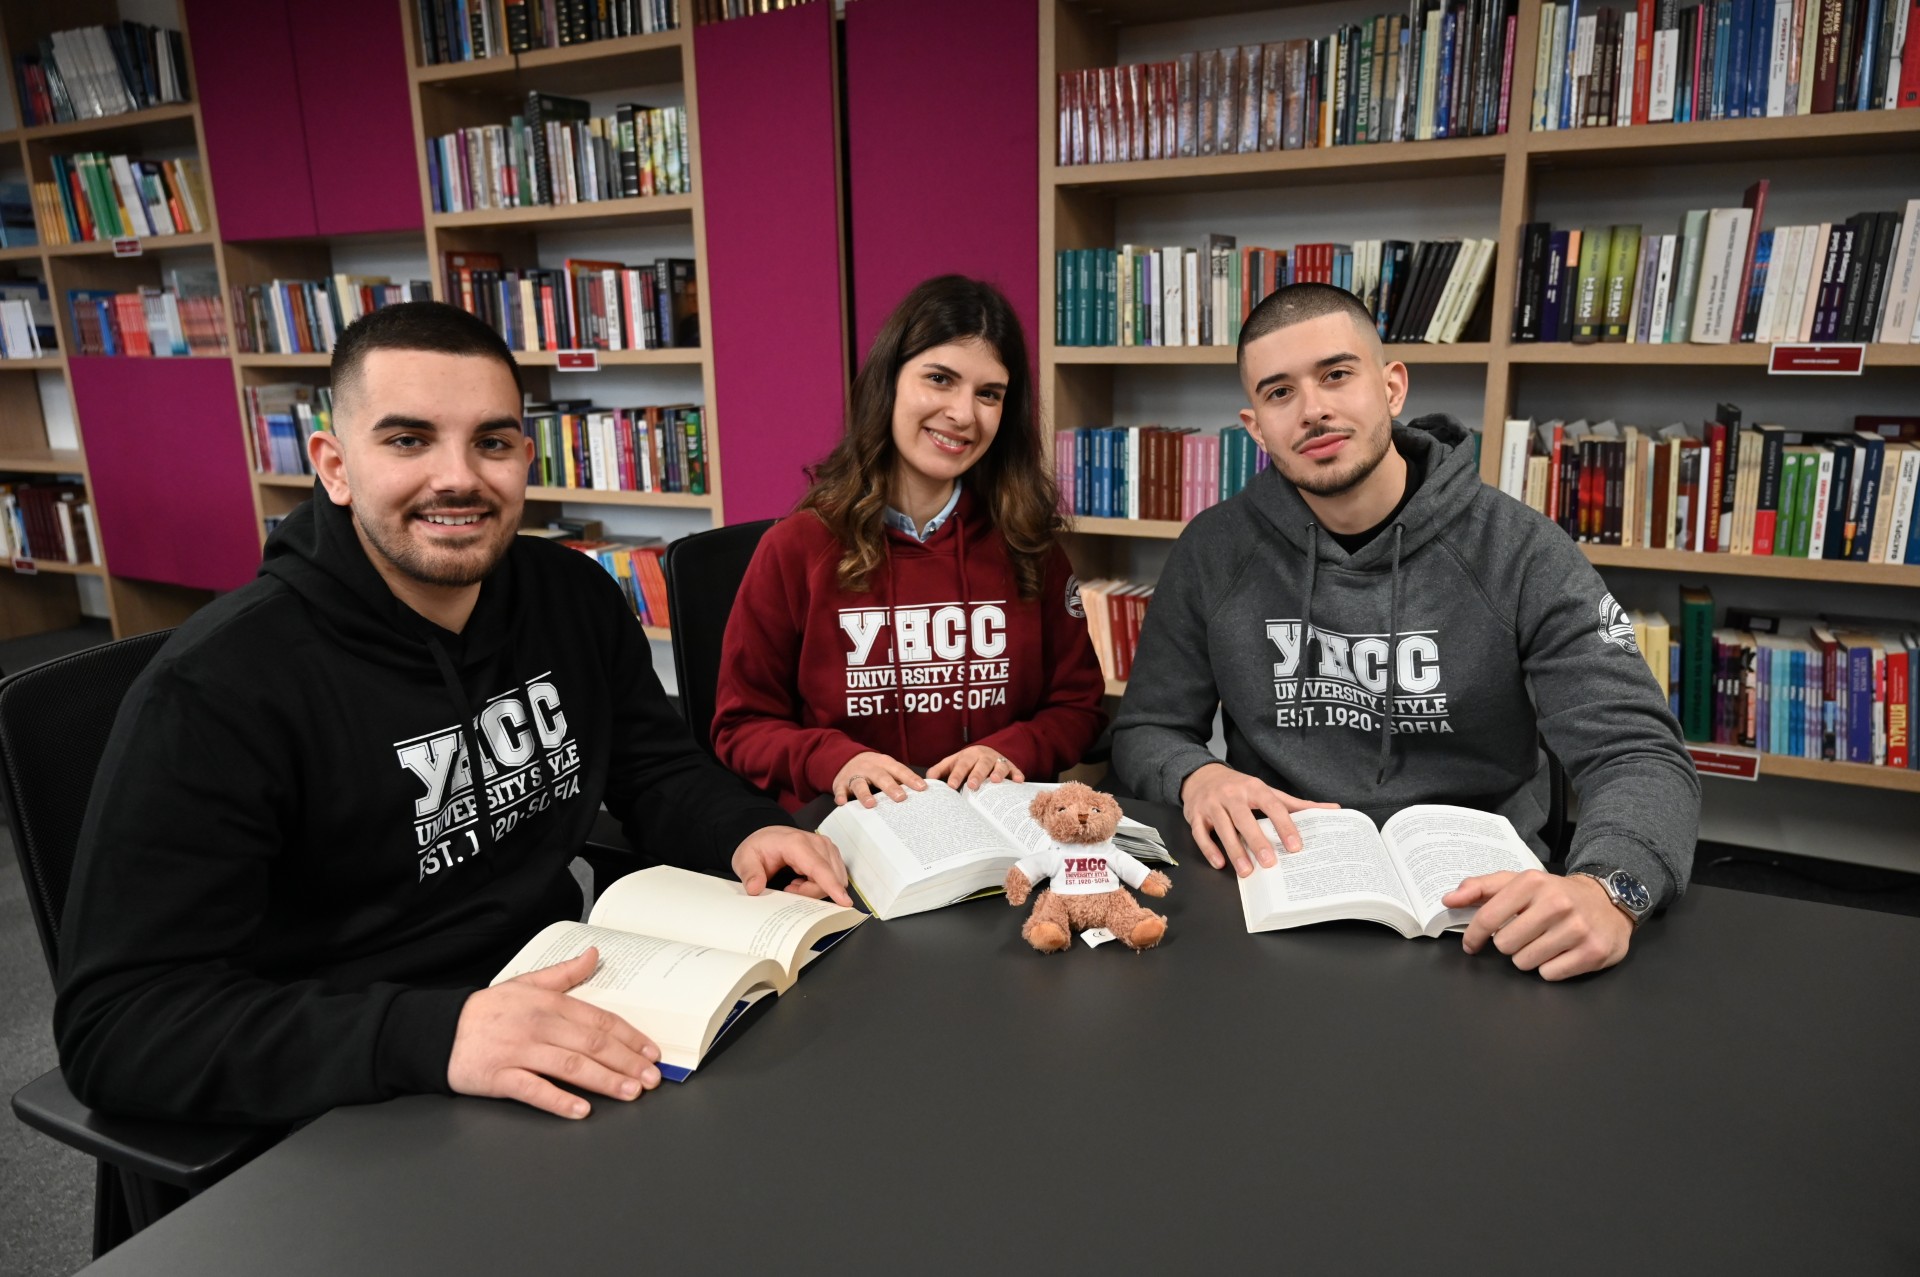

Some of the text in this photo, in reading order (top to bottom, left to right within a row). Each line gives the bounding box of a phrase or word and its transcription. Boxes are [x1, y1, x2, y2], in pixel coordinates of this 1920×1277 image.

[1891, 520, 1902, 560] ФАКТОРЪТ
[846, 663, 1009, 688] UNIVERSITY STYLE
[847, 695, 889, 716] EST.
[1275, 682, 1377, 709] UNIVERSITY
[1277, 707, 1319, 727] EST.
[1890, 704, 1906, 747] ТУРЦИЯ
[531, 744, 579, 787] SYLE
[419, 841, 464, 883] EST.
